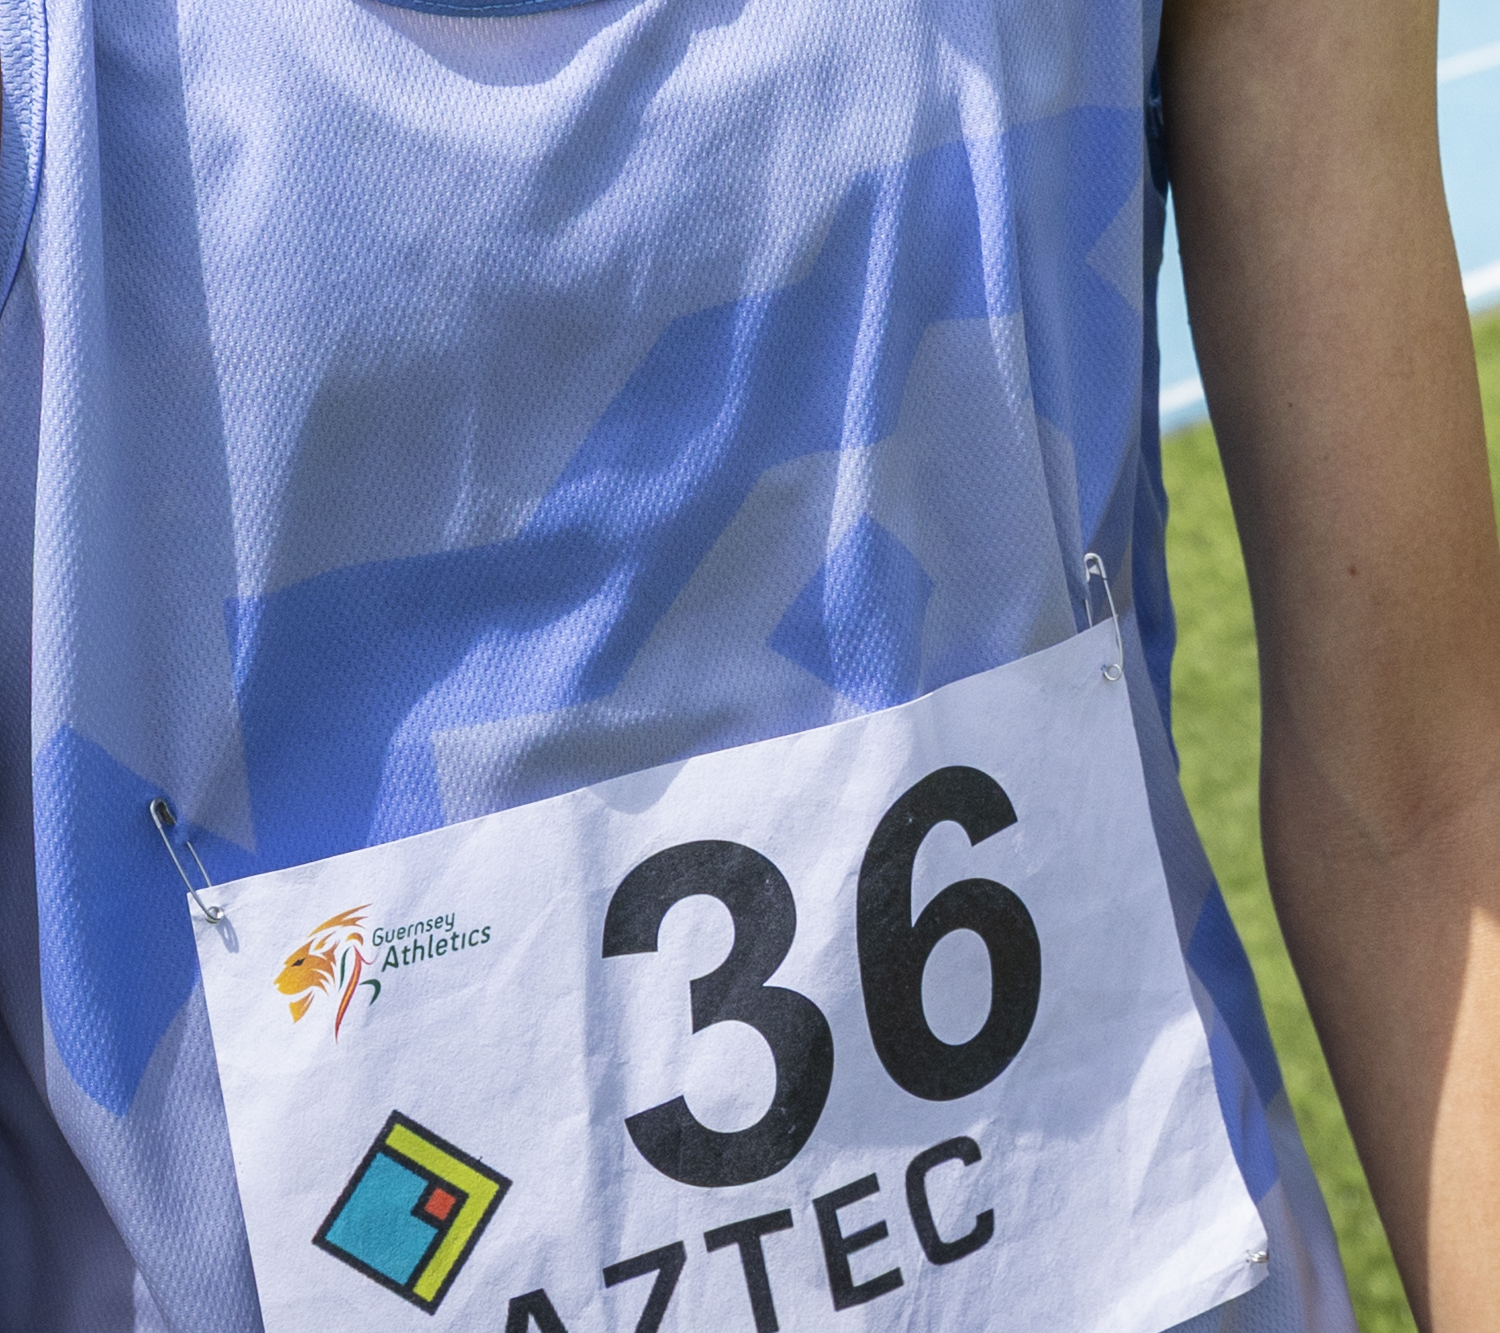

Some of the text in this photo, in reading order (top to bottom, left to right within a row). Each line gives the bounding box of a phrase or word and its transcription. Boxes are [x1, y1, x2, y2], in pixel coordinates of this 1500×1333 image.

[372, 913, 455, 946] Guernsey
[381, 926, 491, 972] Athletics
[602, 764, 1041, 1187] 36
